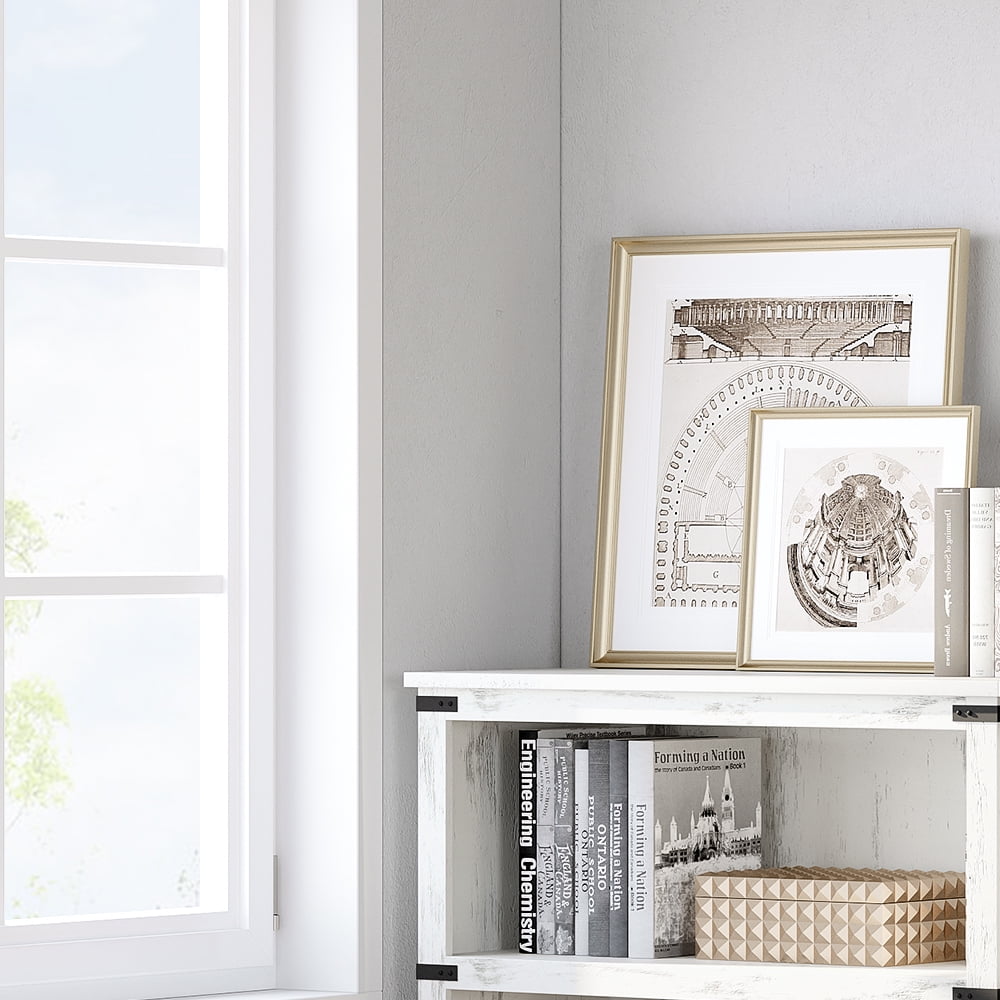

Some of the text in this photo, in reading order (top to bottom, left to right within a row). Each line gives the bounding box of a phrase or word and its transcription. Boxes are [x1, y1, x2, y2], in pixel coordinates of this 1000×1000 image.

[654, 748, 746, 764] Forming a Nation
[560, 756, 570, 818] PUBLIC SCHOOL
[519, 739, 537, 953] Engineering Chemistry
[614, 803, 623, 857] Forming
[636, 804, 647, 857] Forming
[598, 824, 606, 890] ONTARIO
[614, 870, 623, 911] Nation
[636, 870, 647, 912] Nation
